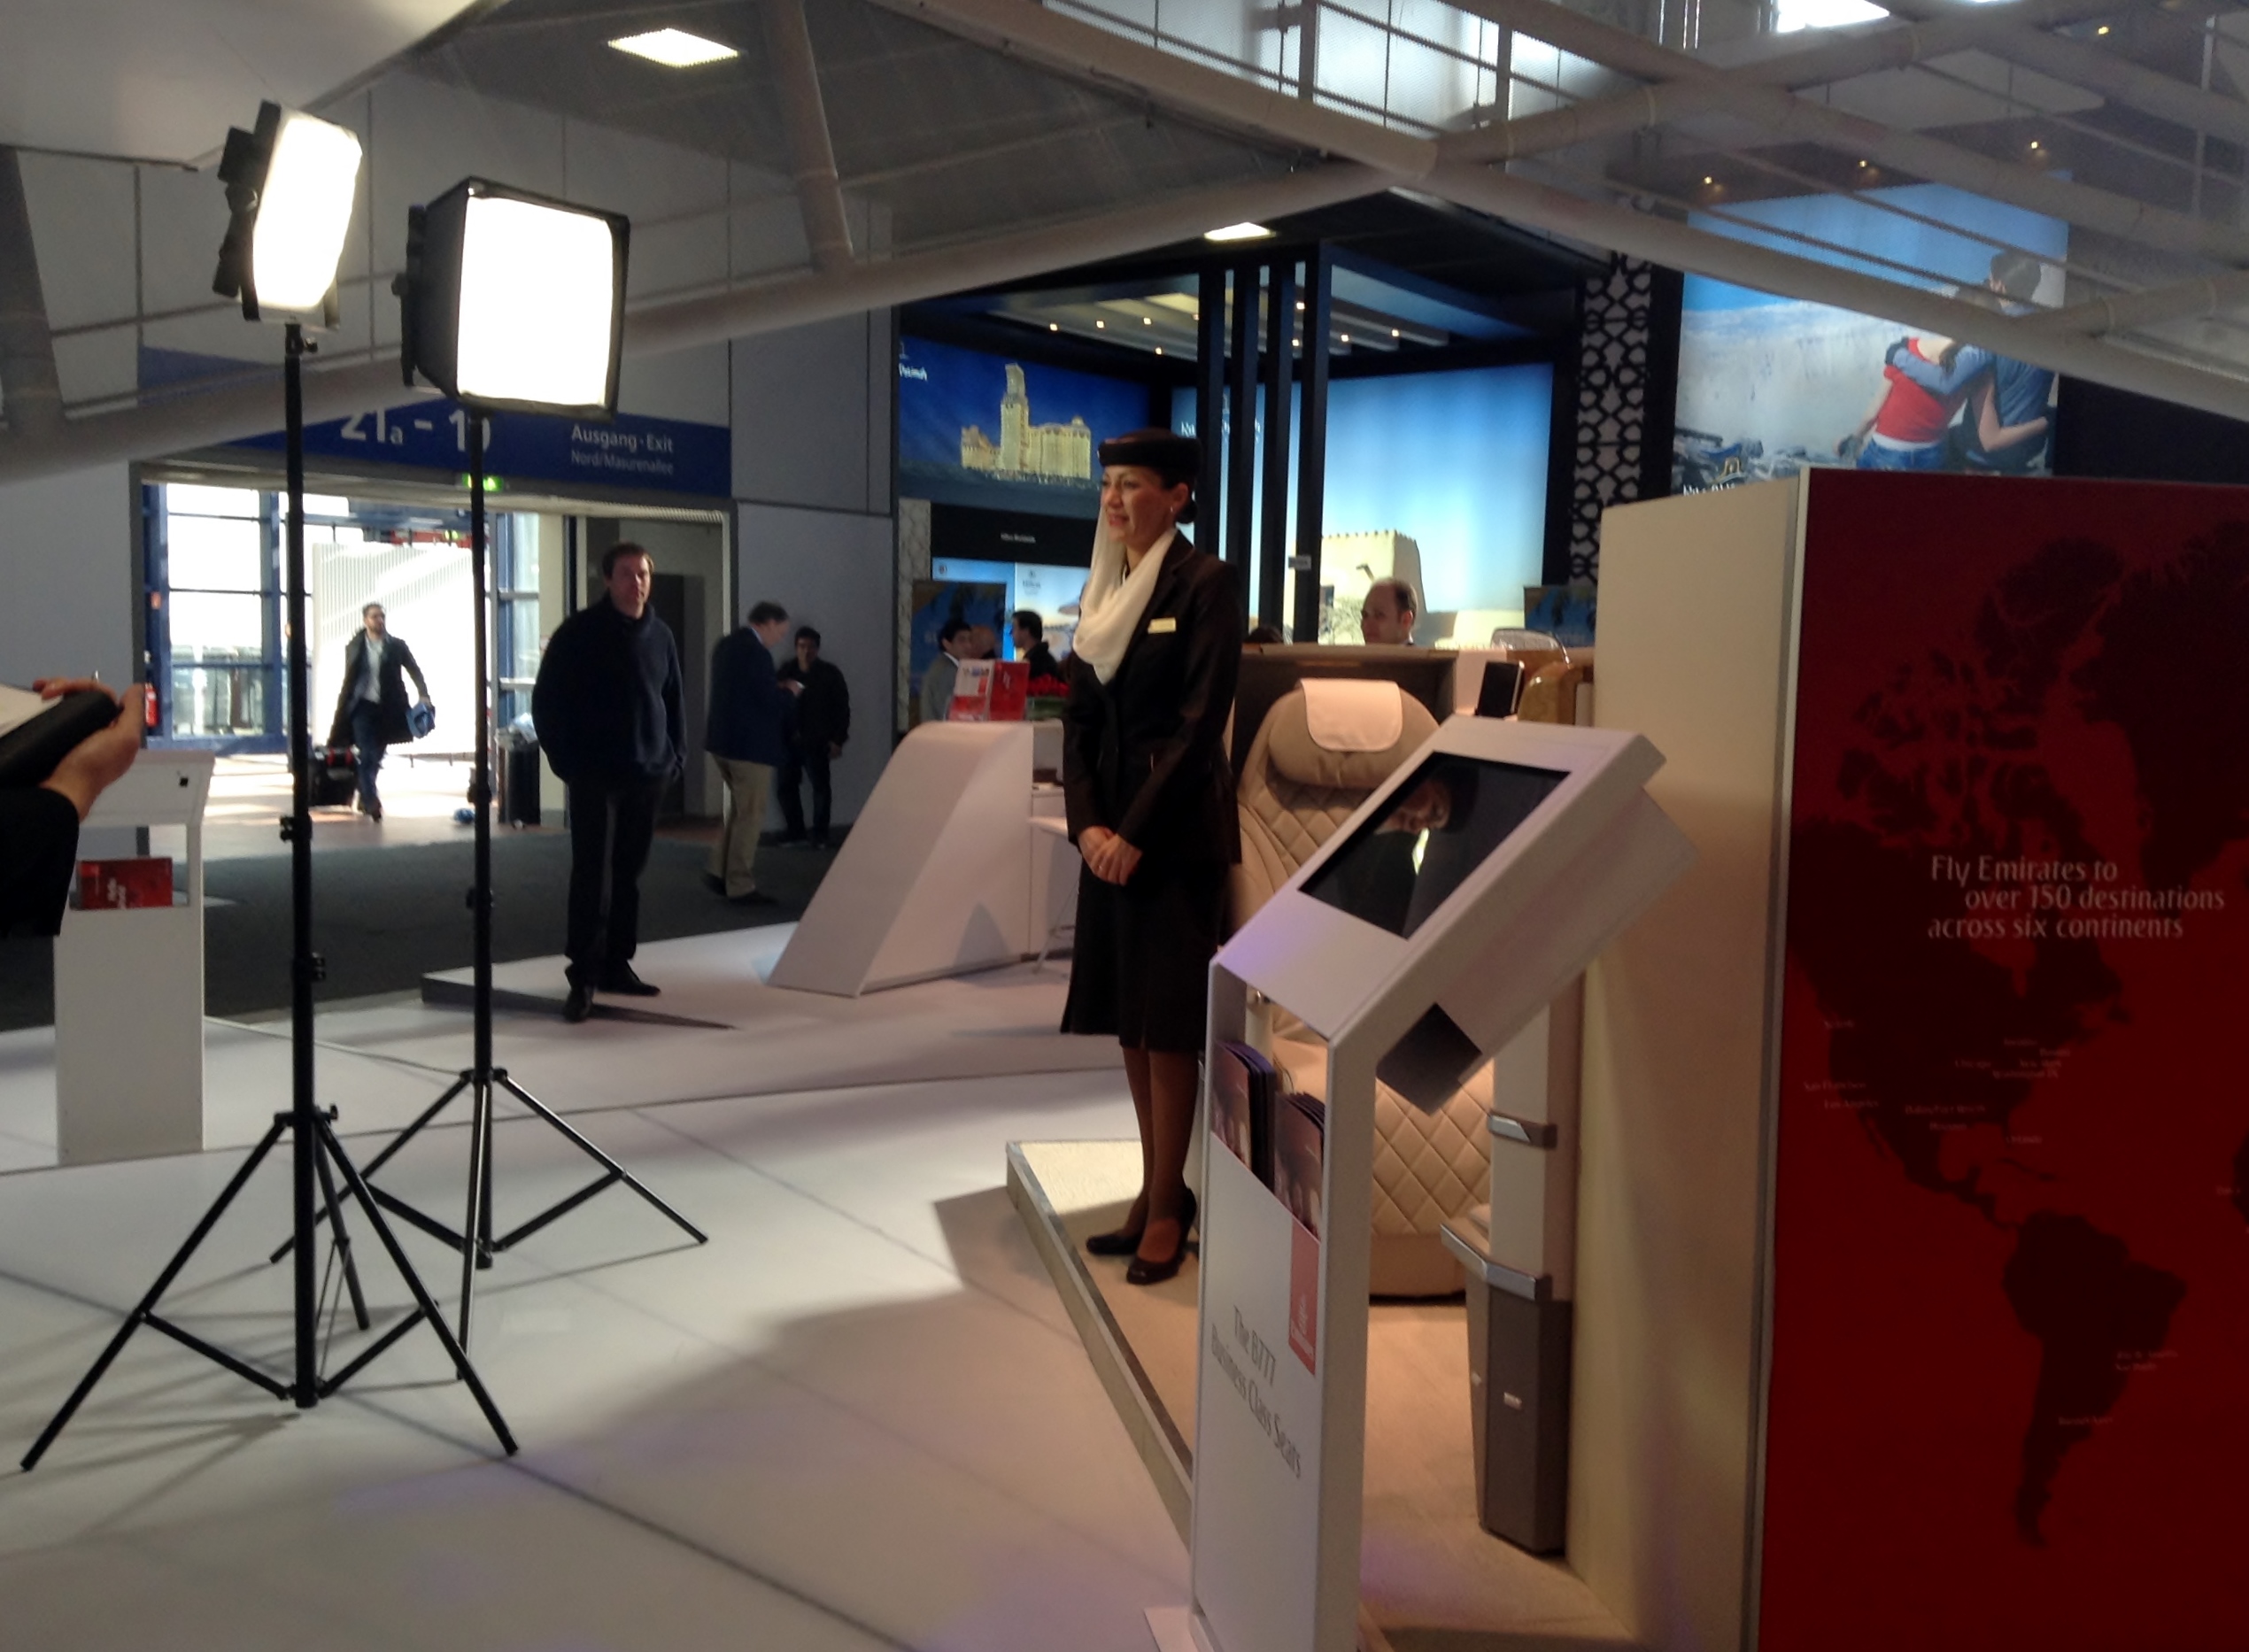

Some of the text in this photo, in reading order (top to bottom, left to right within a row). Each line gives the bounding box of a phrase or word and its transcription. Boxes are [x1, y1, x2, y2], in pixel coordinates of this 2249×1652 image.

[571, 423, 638, 453] Ausgang
[646, 432, 674, 453] Exit
[1931, 854, 2118, 888] Fly Emirates to
[1964, 883, 2225, 911] over 150 destinations
[1928, 913, 2184, 939] across six continents
[1233, 1304, 1249, 1354] The
[1211, 1323, 1301, 1479] Business Class Seats
